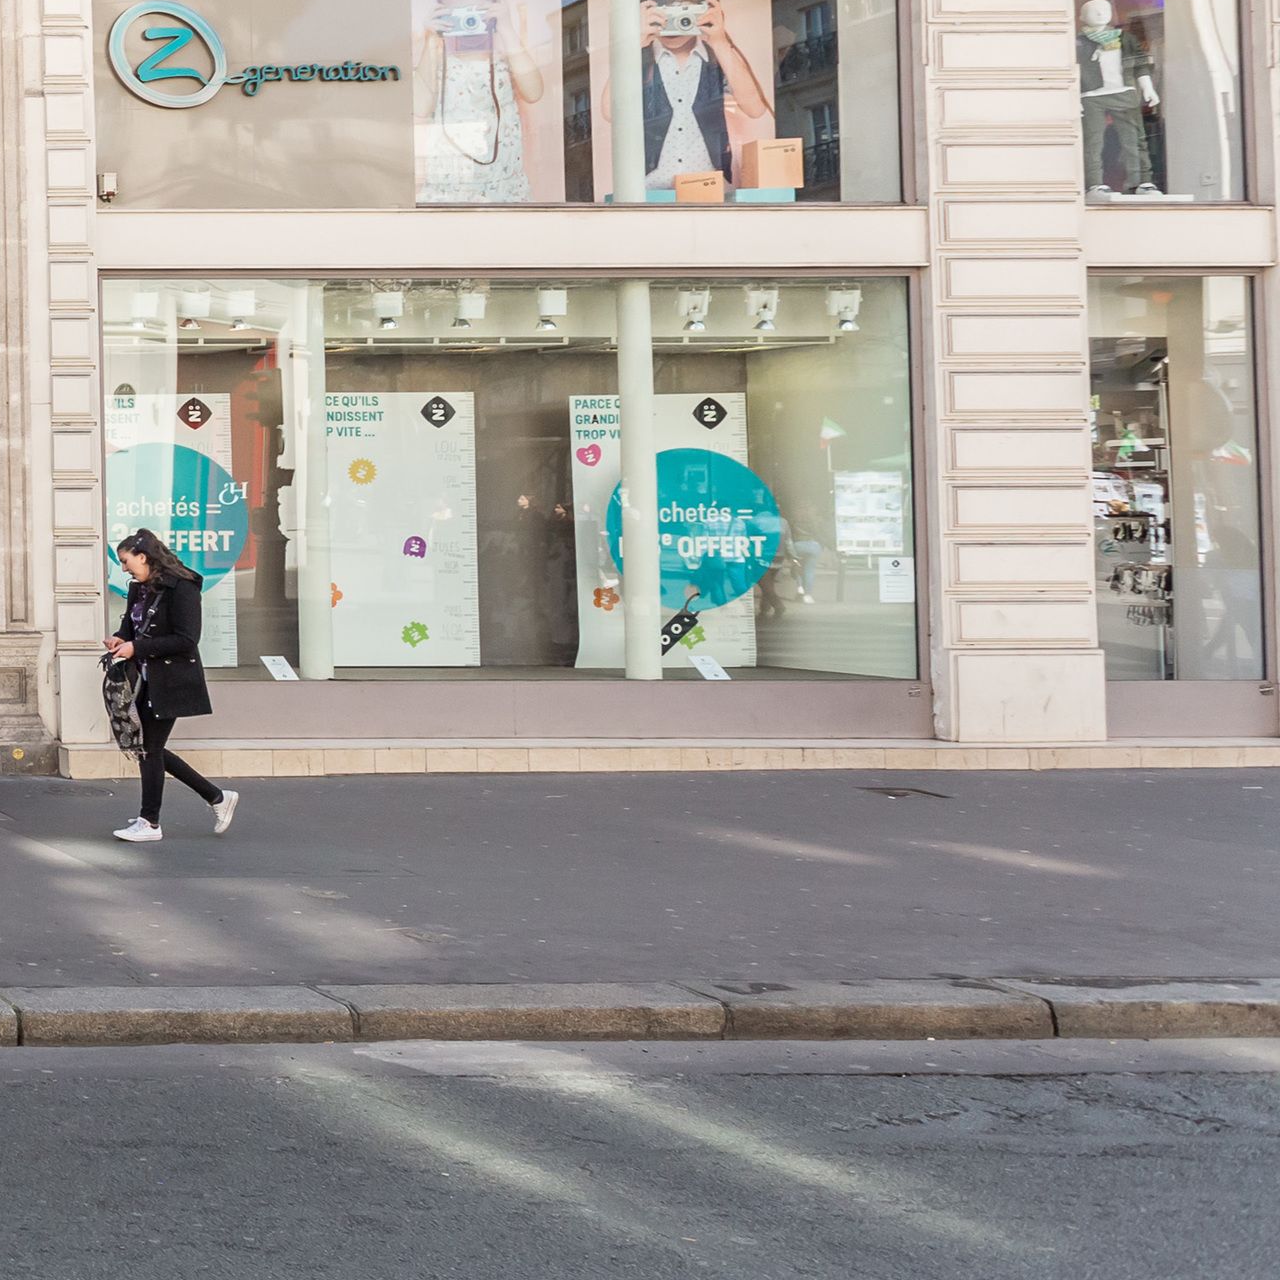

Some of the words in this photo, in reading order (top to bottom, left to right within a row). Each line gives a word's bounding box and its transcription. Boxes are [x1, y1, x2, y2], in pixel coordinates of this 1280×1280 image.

[240, 60, 402, 97] generation
[341, 395, 379, 407] QU'ILS
[574, 398, 611, 409] PARCE
[326, 411, 385, 422] NDISSENT
[336, 427, 362, 437] VITE
[575, 429, 607, 440] TROP
[116, 495, 200, 518] achetés
[659, 500, 732, 523] chetés
[159, 530, 235, 552] FFERT
[677, 535, 767, 558] OFFERT
